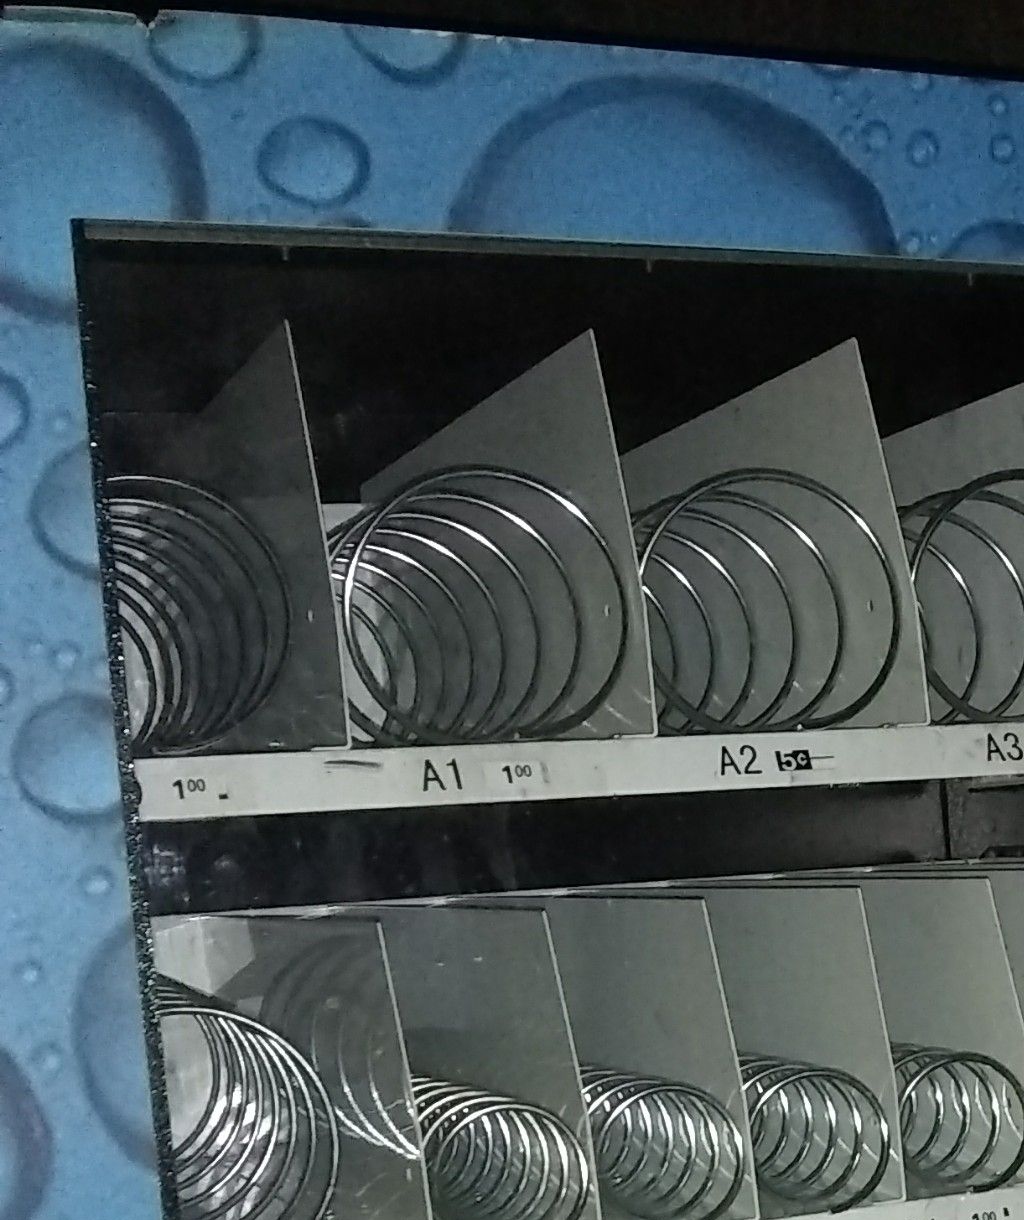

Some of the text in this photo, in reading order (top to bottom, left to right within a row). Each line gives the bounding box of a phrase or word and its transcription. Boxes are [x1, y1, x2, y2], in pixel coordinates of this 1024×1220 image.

[720, 744, 763, 776] A2
[986, 732, 1024, 762] A3
[422, 758, 463, 792] A1
